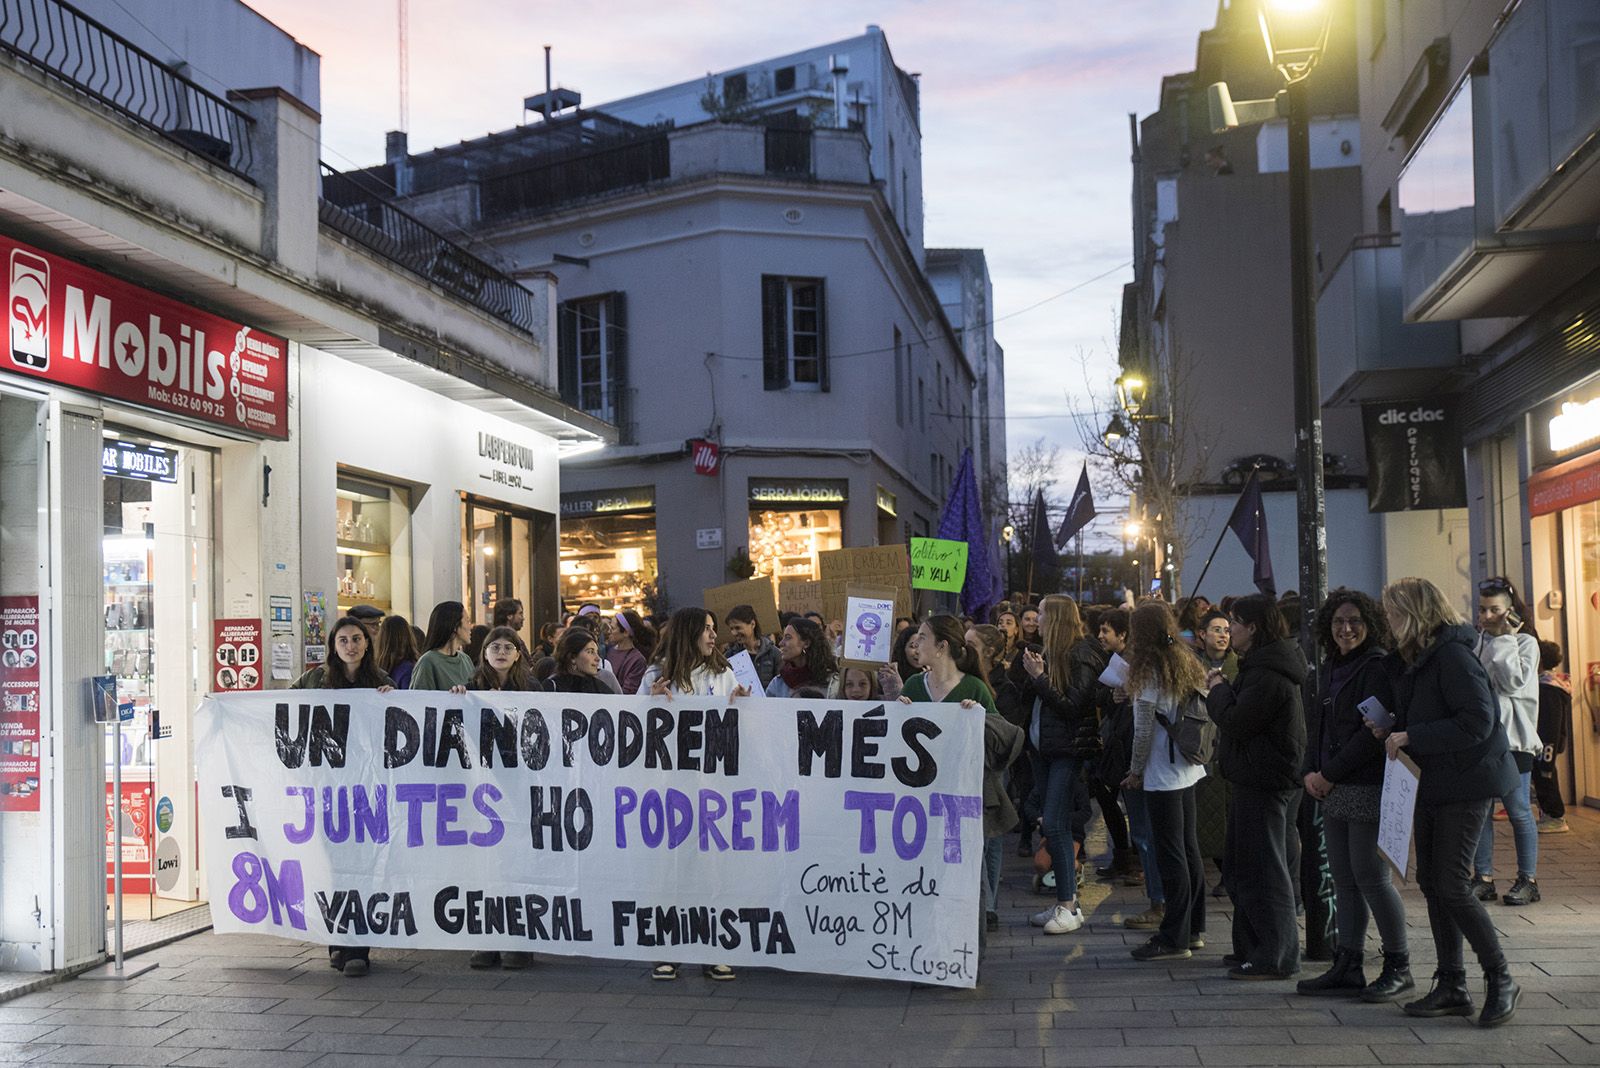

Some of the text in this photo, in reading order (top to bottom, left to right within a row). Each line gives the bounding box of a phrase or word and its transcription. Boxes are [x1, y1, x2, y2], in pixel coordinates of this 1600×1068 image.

[62, 284, 226, 400] Mobils
[148, 386, 225, 417] Mob: 632 60 99 25
[122, 451, 169, 475] MOBILES
[695, 446, 717, 473] illy
[275, 703, 942, 787] UN DIA NO PODREM MÉS
[221, 783, 982, 863] I JUNTES HO PODREM TOT
[158, 855, 178, 871] Lowi
[800, 864, 939, 897] Comitè de
[228, 851, 307, 931] 8M
[314, 890, 418, 936] VAGA
[434, 885, 593, 941] GENERAL
[805, 901, 913, 945] Vaga 8M
